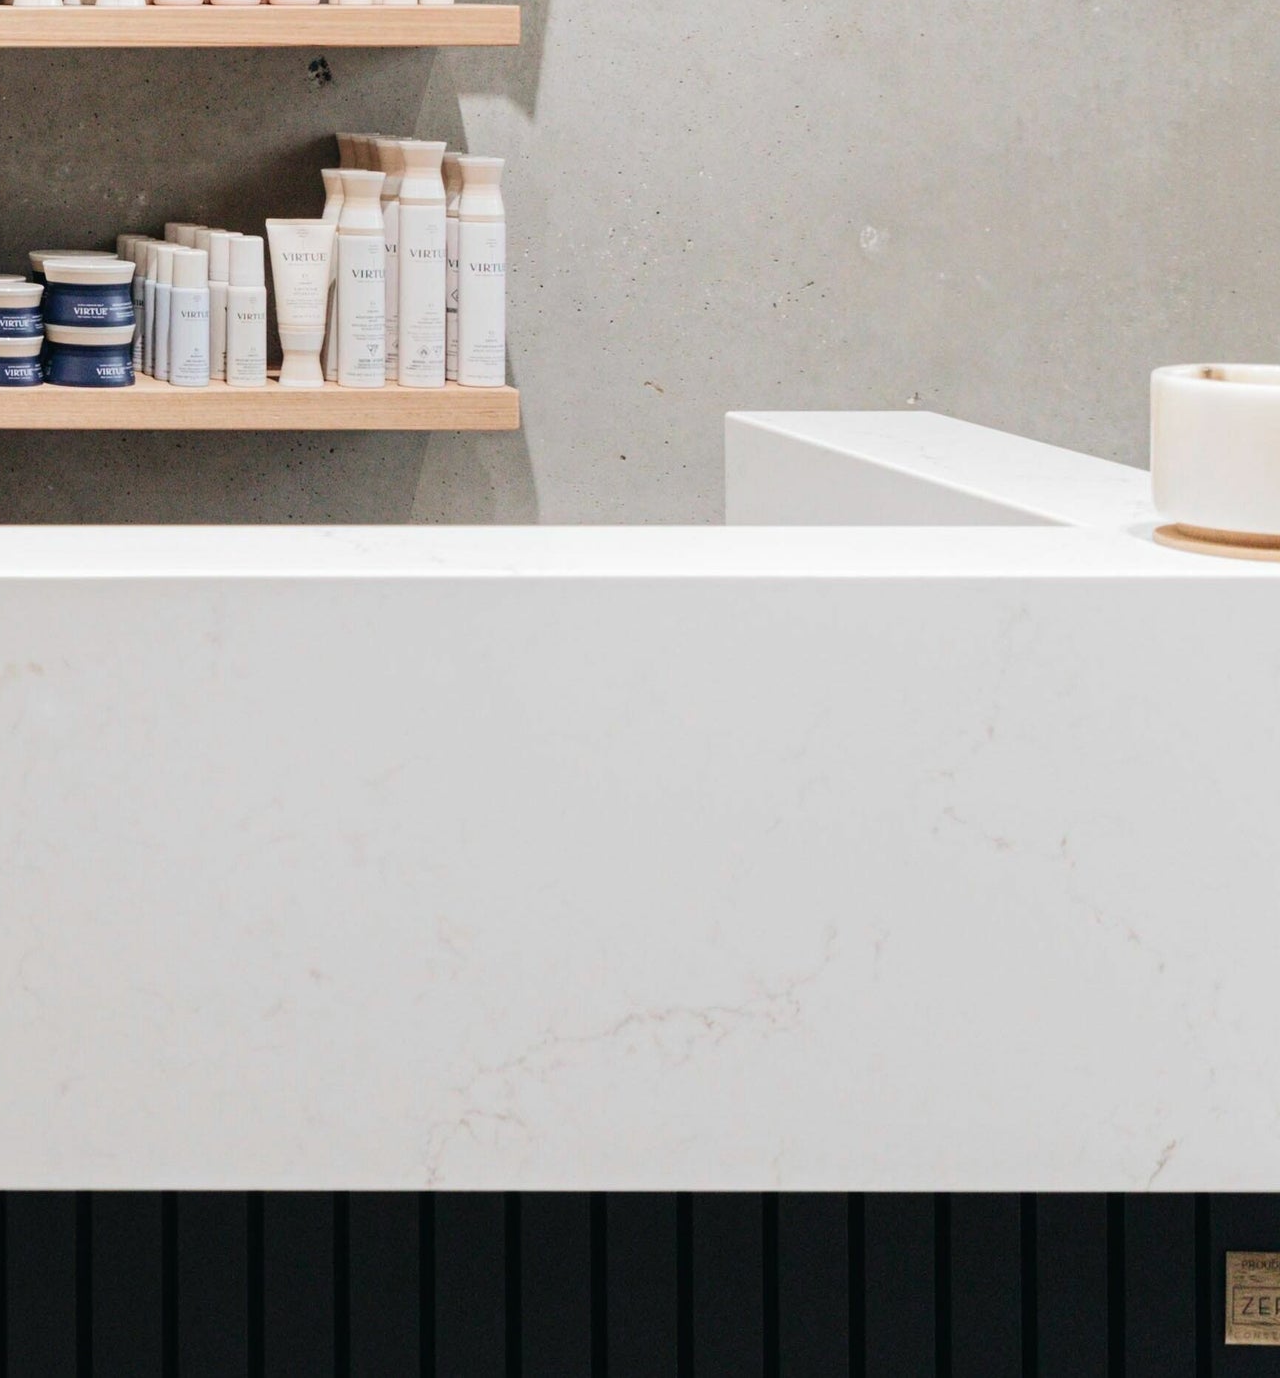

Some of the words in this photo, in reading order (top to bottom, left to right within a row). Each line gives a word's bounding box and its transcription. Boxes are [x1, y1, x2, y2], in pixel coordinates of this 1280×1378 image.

[282, 253, 327, 262] VIRTUE
[410, 249, 445, 258] VIRTU
[470, 263, 506, 272] VIRTU
[352, 269, 384, 279] VIRTU
[74, 307, 109, 316] VIRTUE
[0, 319, 30, 328] VIRTUE
[4, 368, 34, 377] VIRTUE
[96, 367, 126, 376] VIRTUE
